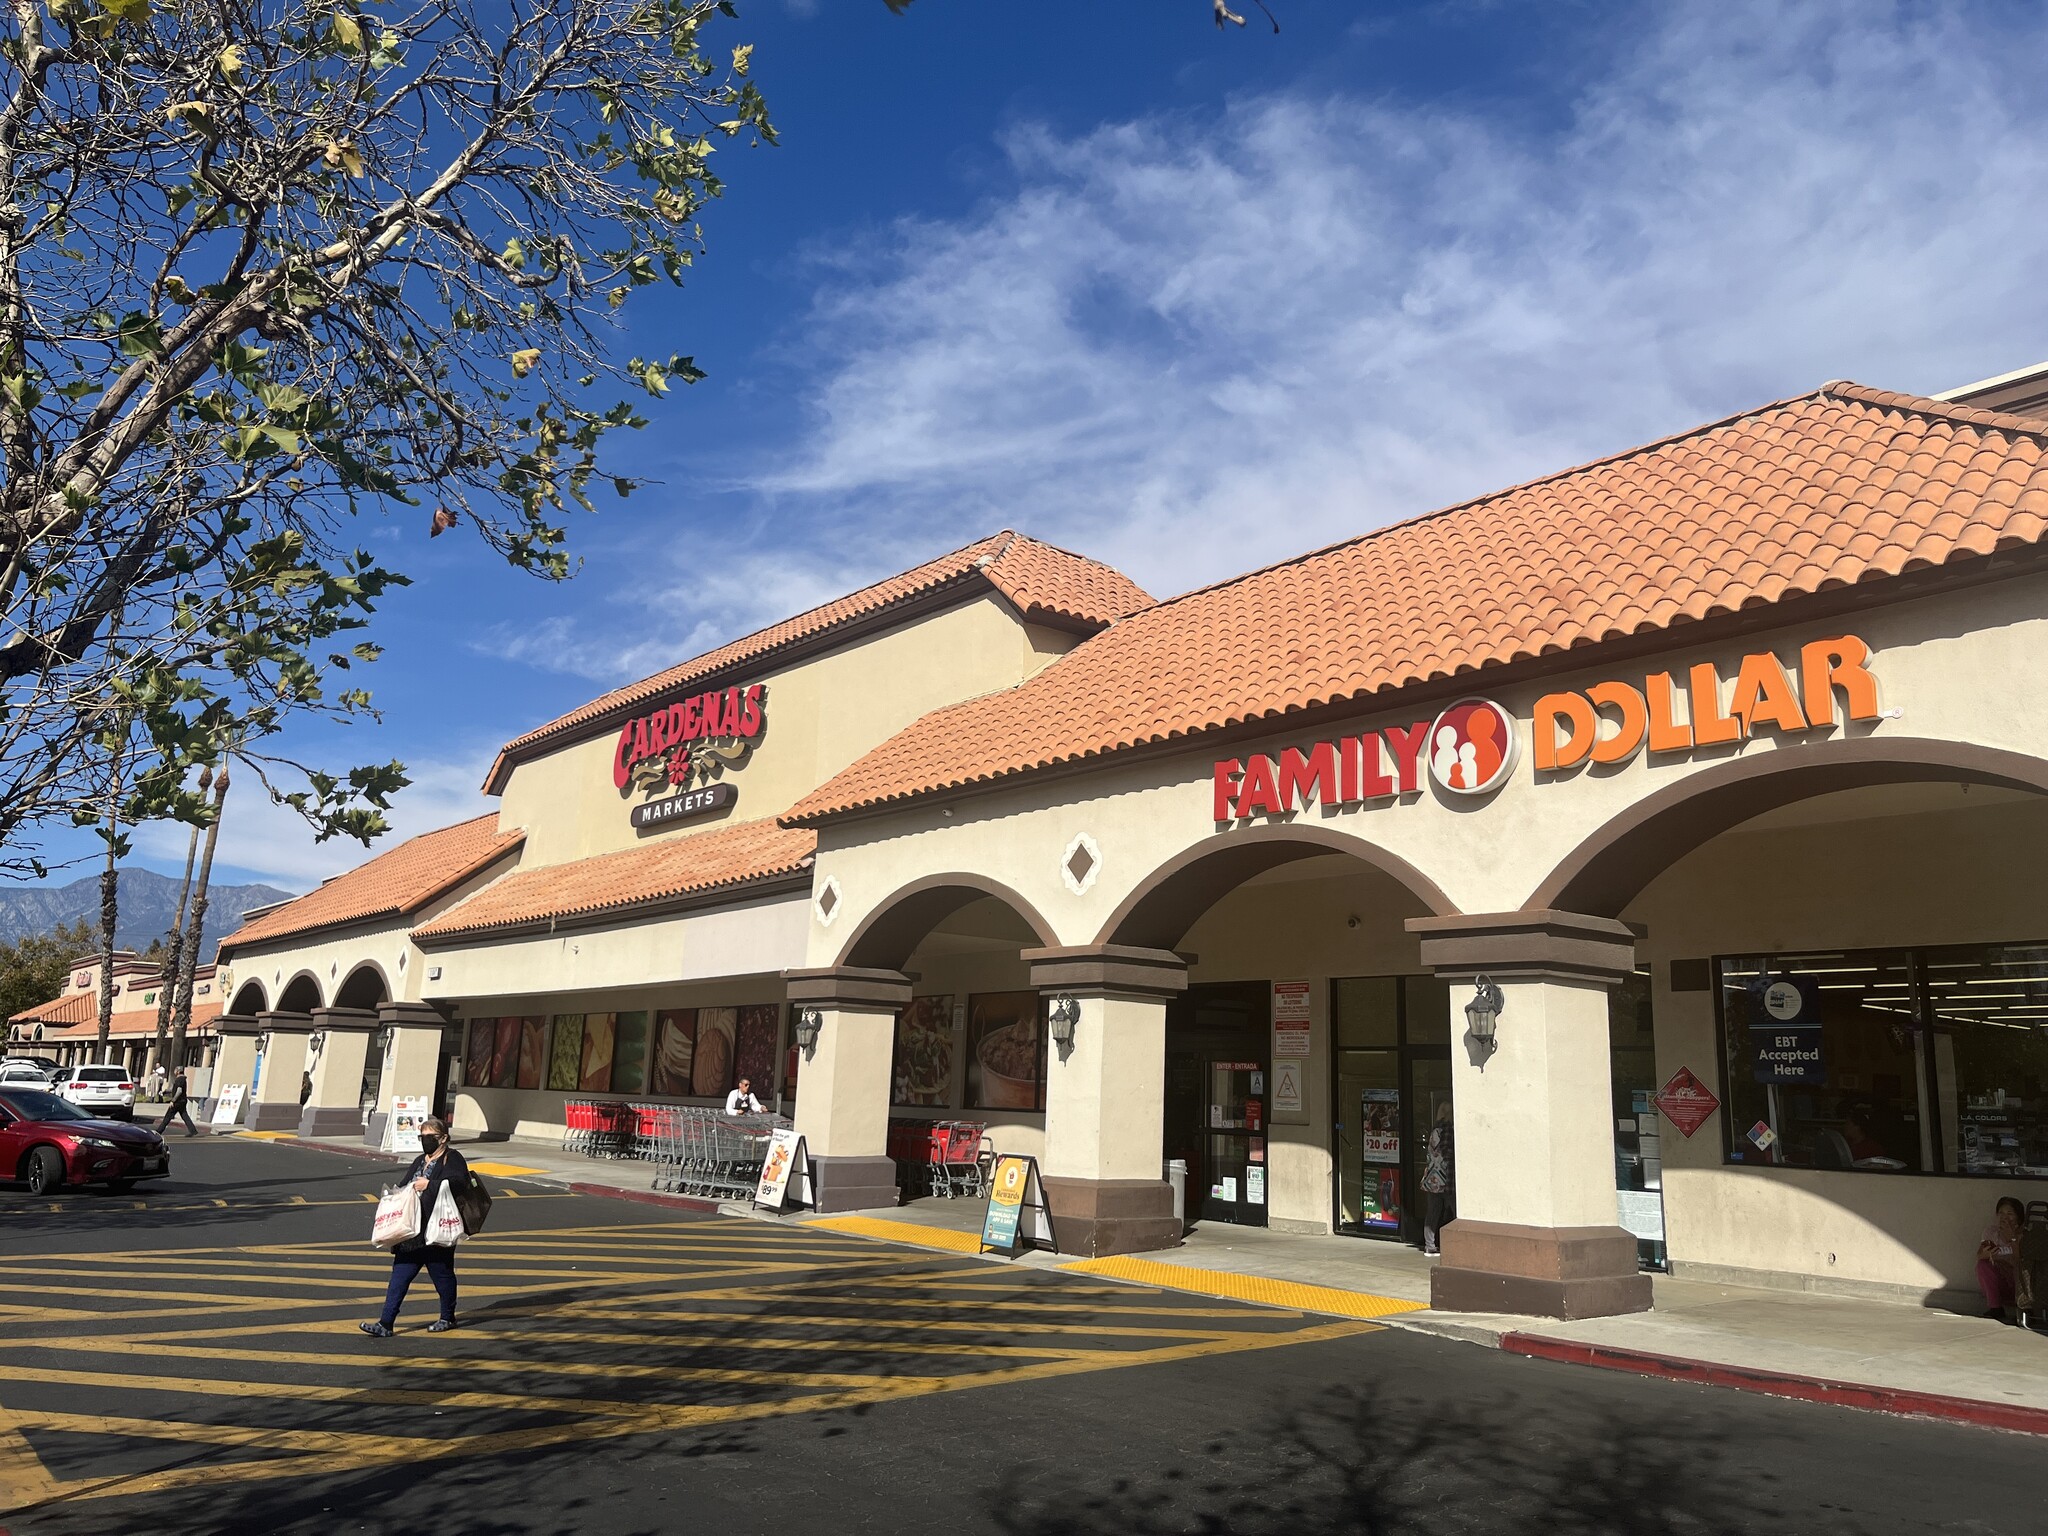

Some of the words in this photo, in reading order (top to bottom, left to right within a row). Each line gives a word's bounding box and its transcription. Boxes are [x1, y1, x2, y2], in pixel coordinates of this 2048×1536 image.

[1213, 720, 1431, 822] FAMILY
[1532, 634, 1878, 770] DOLLAR
[613, 684, 765, 789] CARDENAS
[642, 790, 715, 821] MARKETS
[1775, 1036, 1797, 1047] EBT
[1759, 1048, 1818, 1063] Accepted
[1774, 1064, 1804, 1075] Here
[1254, 1076, 1261, 1086] A
[1366, 1139, 1380, 1149] $20
[1383, 1139, 1398, 1150] off
[995, 1189, 1020, 1200] Rewards
